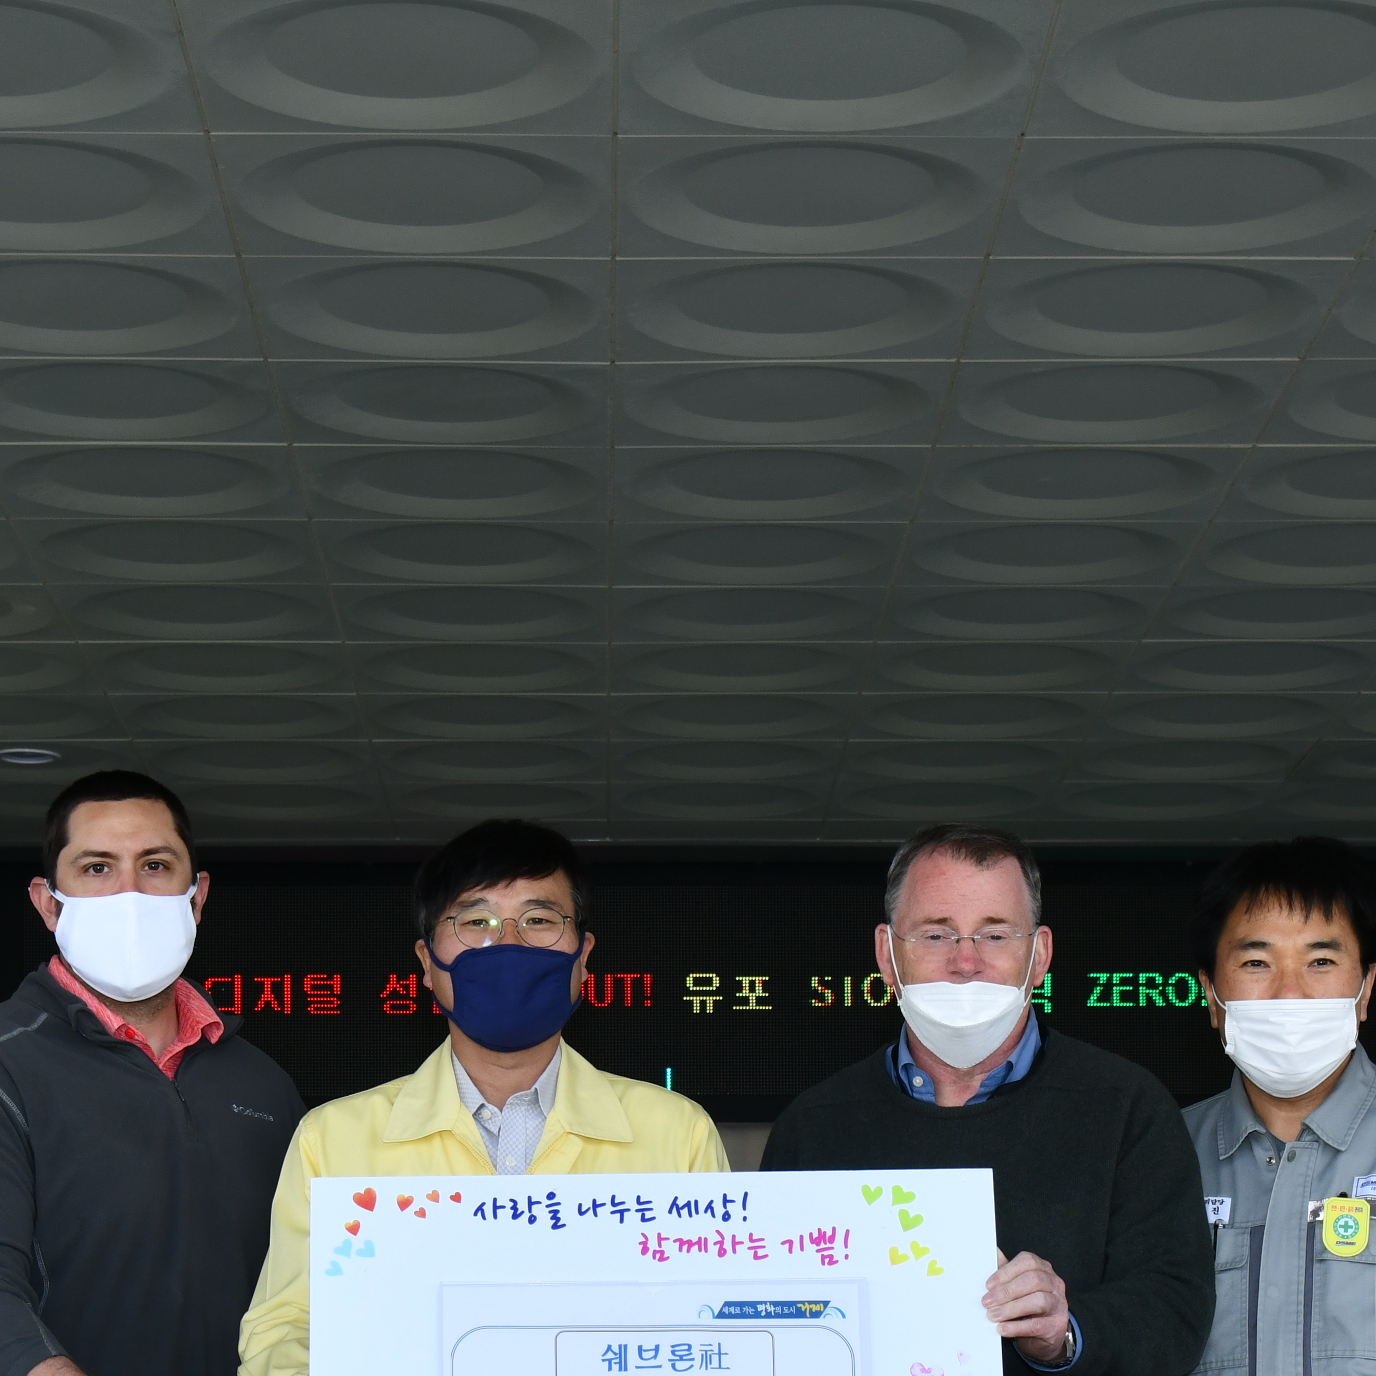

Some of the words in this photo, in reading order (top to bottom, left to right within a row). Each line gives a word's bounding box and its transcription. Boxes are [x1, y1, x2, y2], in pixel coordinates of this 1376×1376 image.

[205, 974, 341, 1014] 디지털
[581, 974, 653, 1007] UT!
[683, 972, 772, 1014] 유포
[473, 1191, 566, 1229] 사랑을
[578, 1195, 656, 1224] 나누는
[668, 1191, 748, 1222] 세상!
[638, 1230, 768, 1262] 함께하는
[781, 1229, 849, 1266] 기쁨!
[602, 1343, 730, 1372] 쉐브론社
